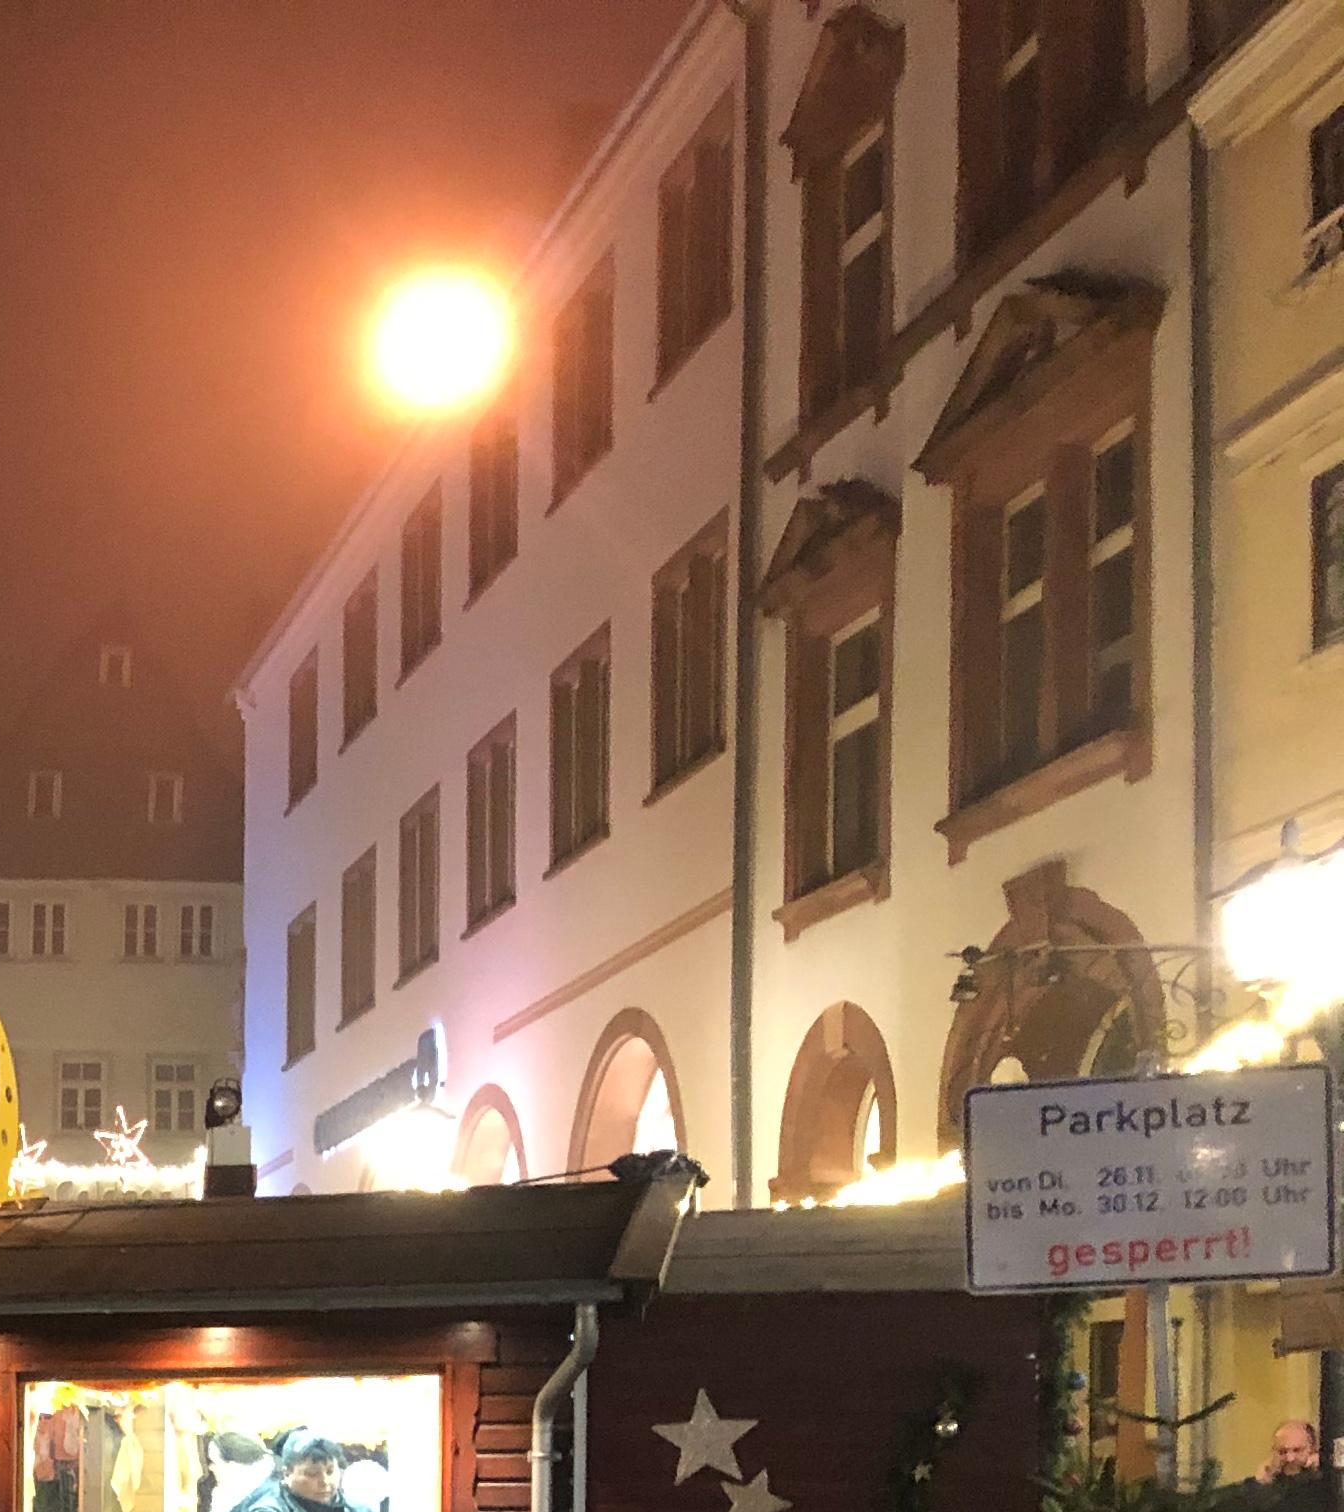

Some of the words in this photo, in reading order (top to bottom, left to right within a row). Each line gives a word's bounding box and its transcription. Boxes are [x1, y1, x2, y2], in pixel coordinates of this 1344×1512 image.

[1040, 1096, 1251, 1138] Parkplatz
[987, 1176, 1032, 1193] von
[1262, 1157, 1311, 1178] Uhr
[987, 1202, 1024, 1220] bis
[1039, 1198, 1082, 1217] Mo.
[1262, 1184, 1311, 1206] Uhr
[1047, 1225, 1250, 1277] gesperrt!
